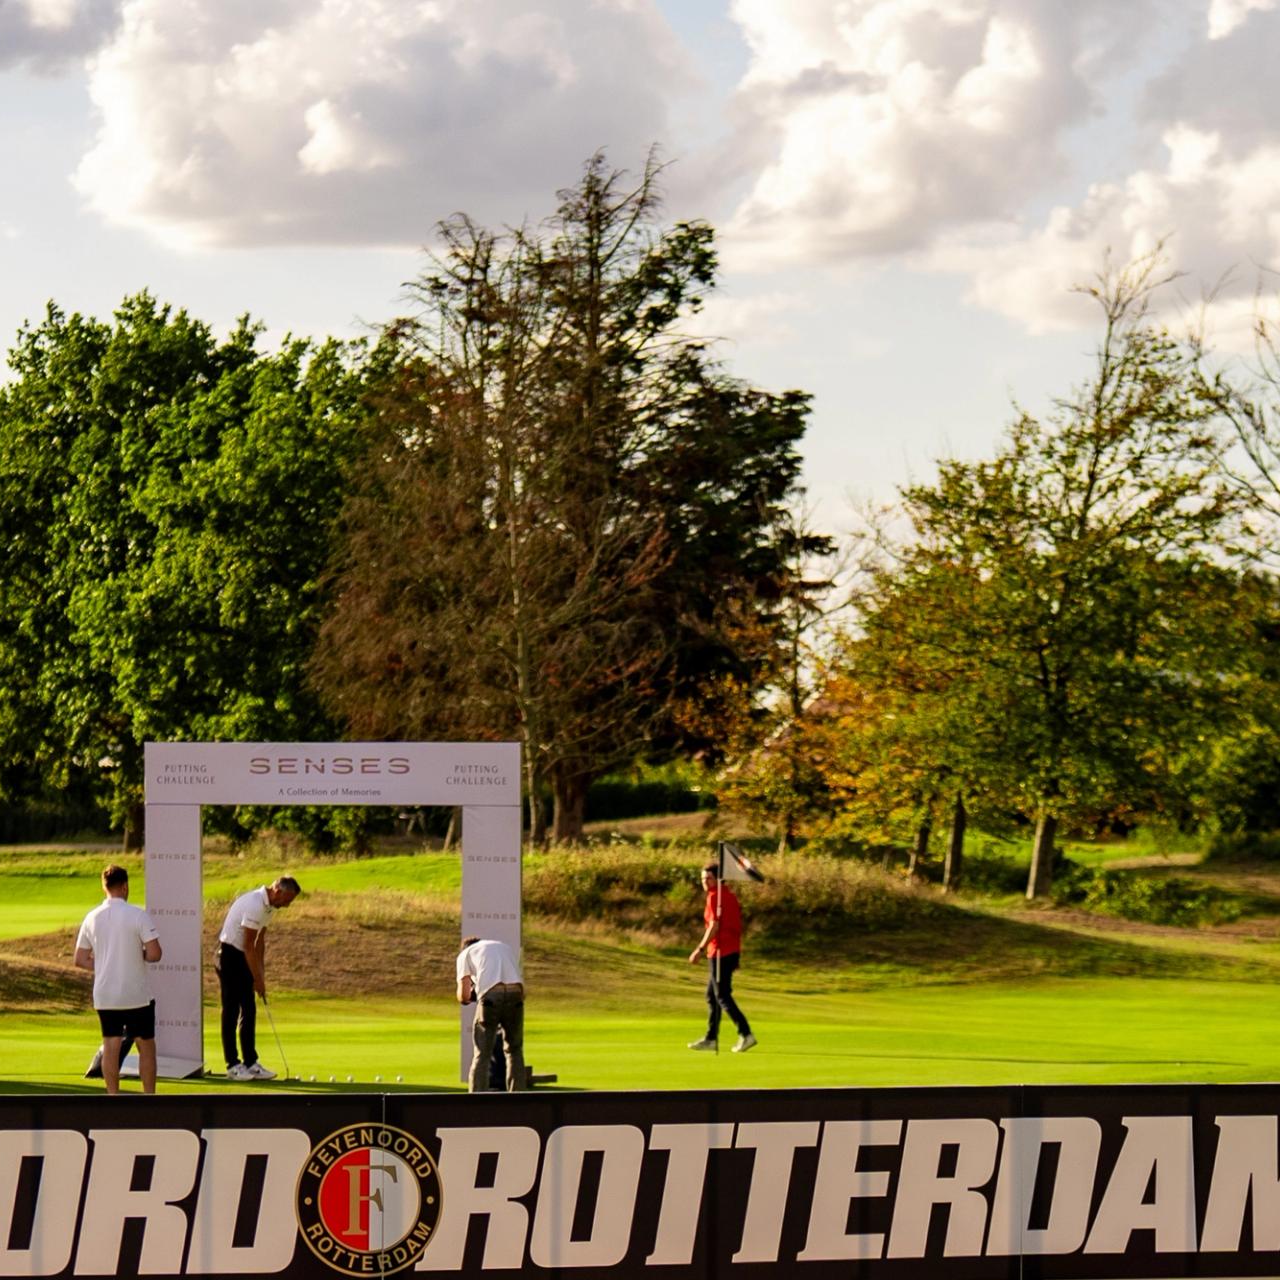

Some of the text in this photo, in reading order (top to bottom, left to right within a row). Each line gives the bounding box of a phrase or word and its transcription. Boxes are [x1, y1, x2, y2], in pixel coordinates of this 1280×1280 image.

[164, 764, 207, 774] PUTTING
[249, 757, 411, 775] SENSES
[454, 764, 499, 774] PUTTING
[156, 775, 216, 785] CHALLENGE
[445, 776, 508, 786] CHALLENGE
[278, 787, 382, 797] A Collection of Memories
[306, 1128, 433, 1179] FEYENOORD
[341, 1164, 399, 1236] F
[306, 1221, 433, 1272] ROTTERDAM
